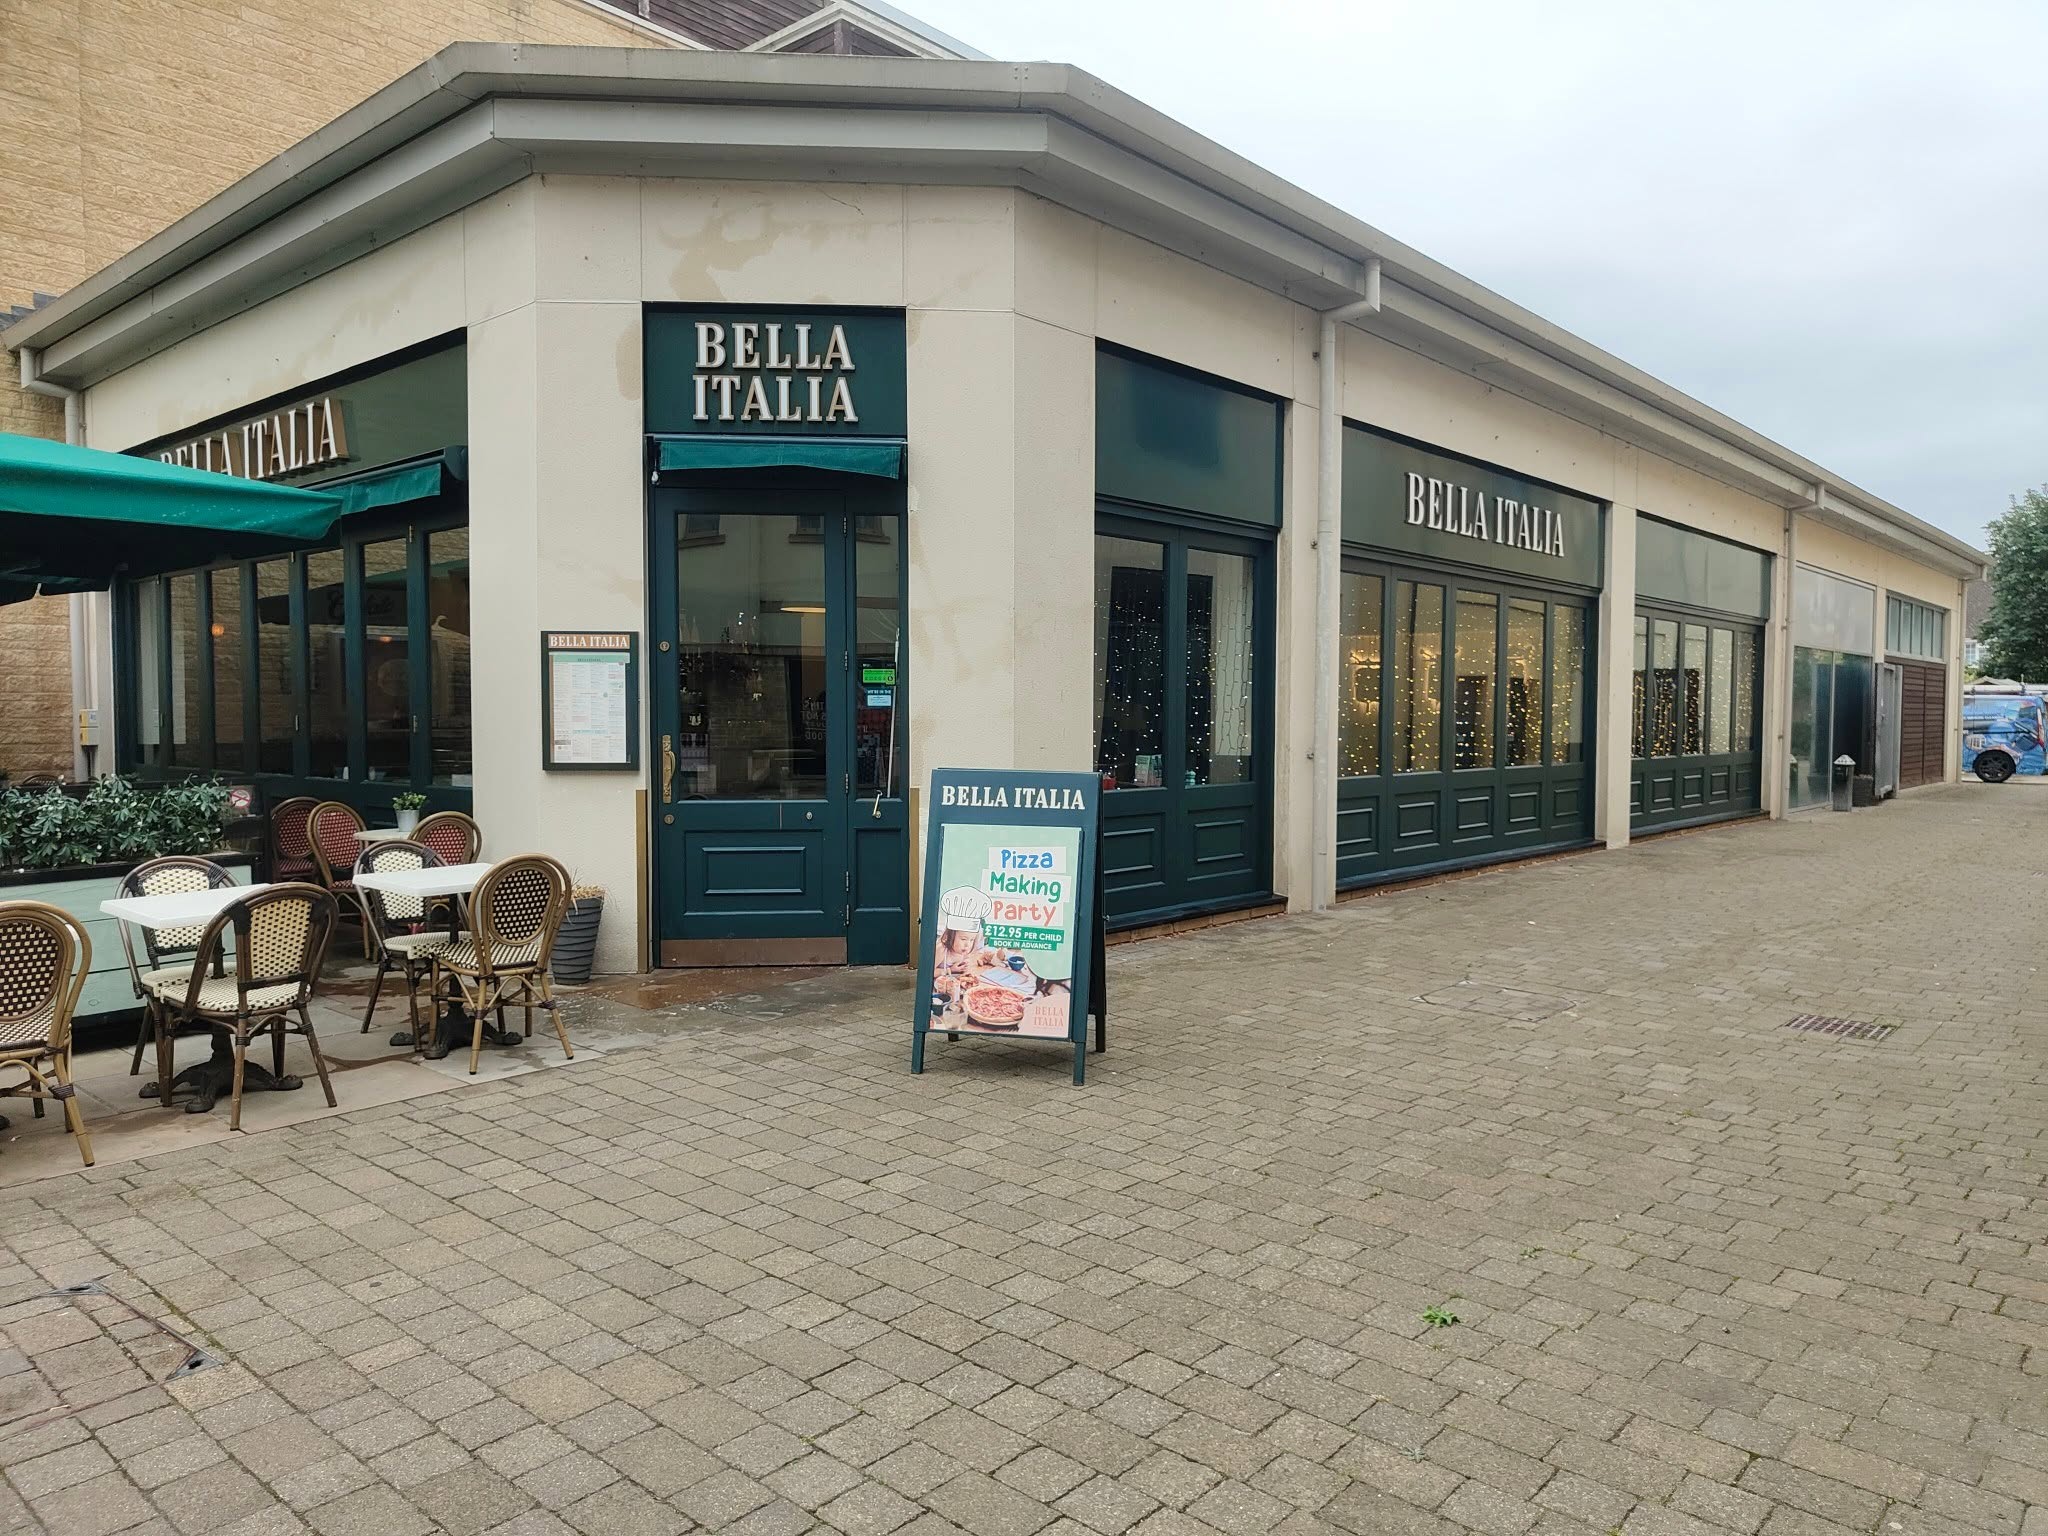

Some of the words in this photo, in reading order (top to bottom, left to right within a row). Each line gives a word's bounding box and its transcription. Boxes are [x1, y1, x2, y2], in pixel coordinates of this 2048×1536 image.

[694, 322, 856, 370] BELLA
[693, 375, 859, 422] ITALIA
[242, 397, 346, 479] ITALIA
[1406, 472, 1488, 540] BELLA
[1495, 497, 1565, 557] ITALIA
[550, 635, 587, 647] BELLA
[589, 636, 628, 647] ITALIA
[941, 785, 1008, 808] BELLA
[1014, 787, 1086, 810] ITALIA
[1001, 849, 1054, 869] Pizza
[990, 871, 1062, 903] Making
[993, 900, 1057, 927] Party
[985, 925, 1022, 938] £12.95
[1024, 931, 1038, 940] PER
[1039, 933, 1062, 942] CHILD
[1021, 941, 1053, 950] ADVANCE
[1033, 1016, 1064, 1027] ITALIA
[1035, 1006, 1064, 1016] BELLA
